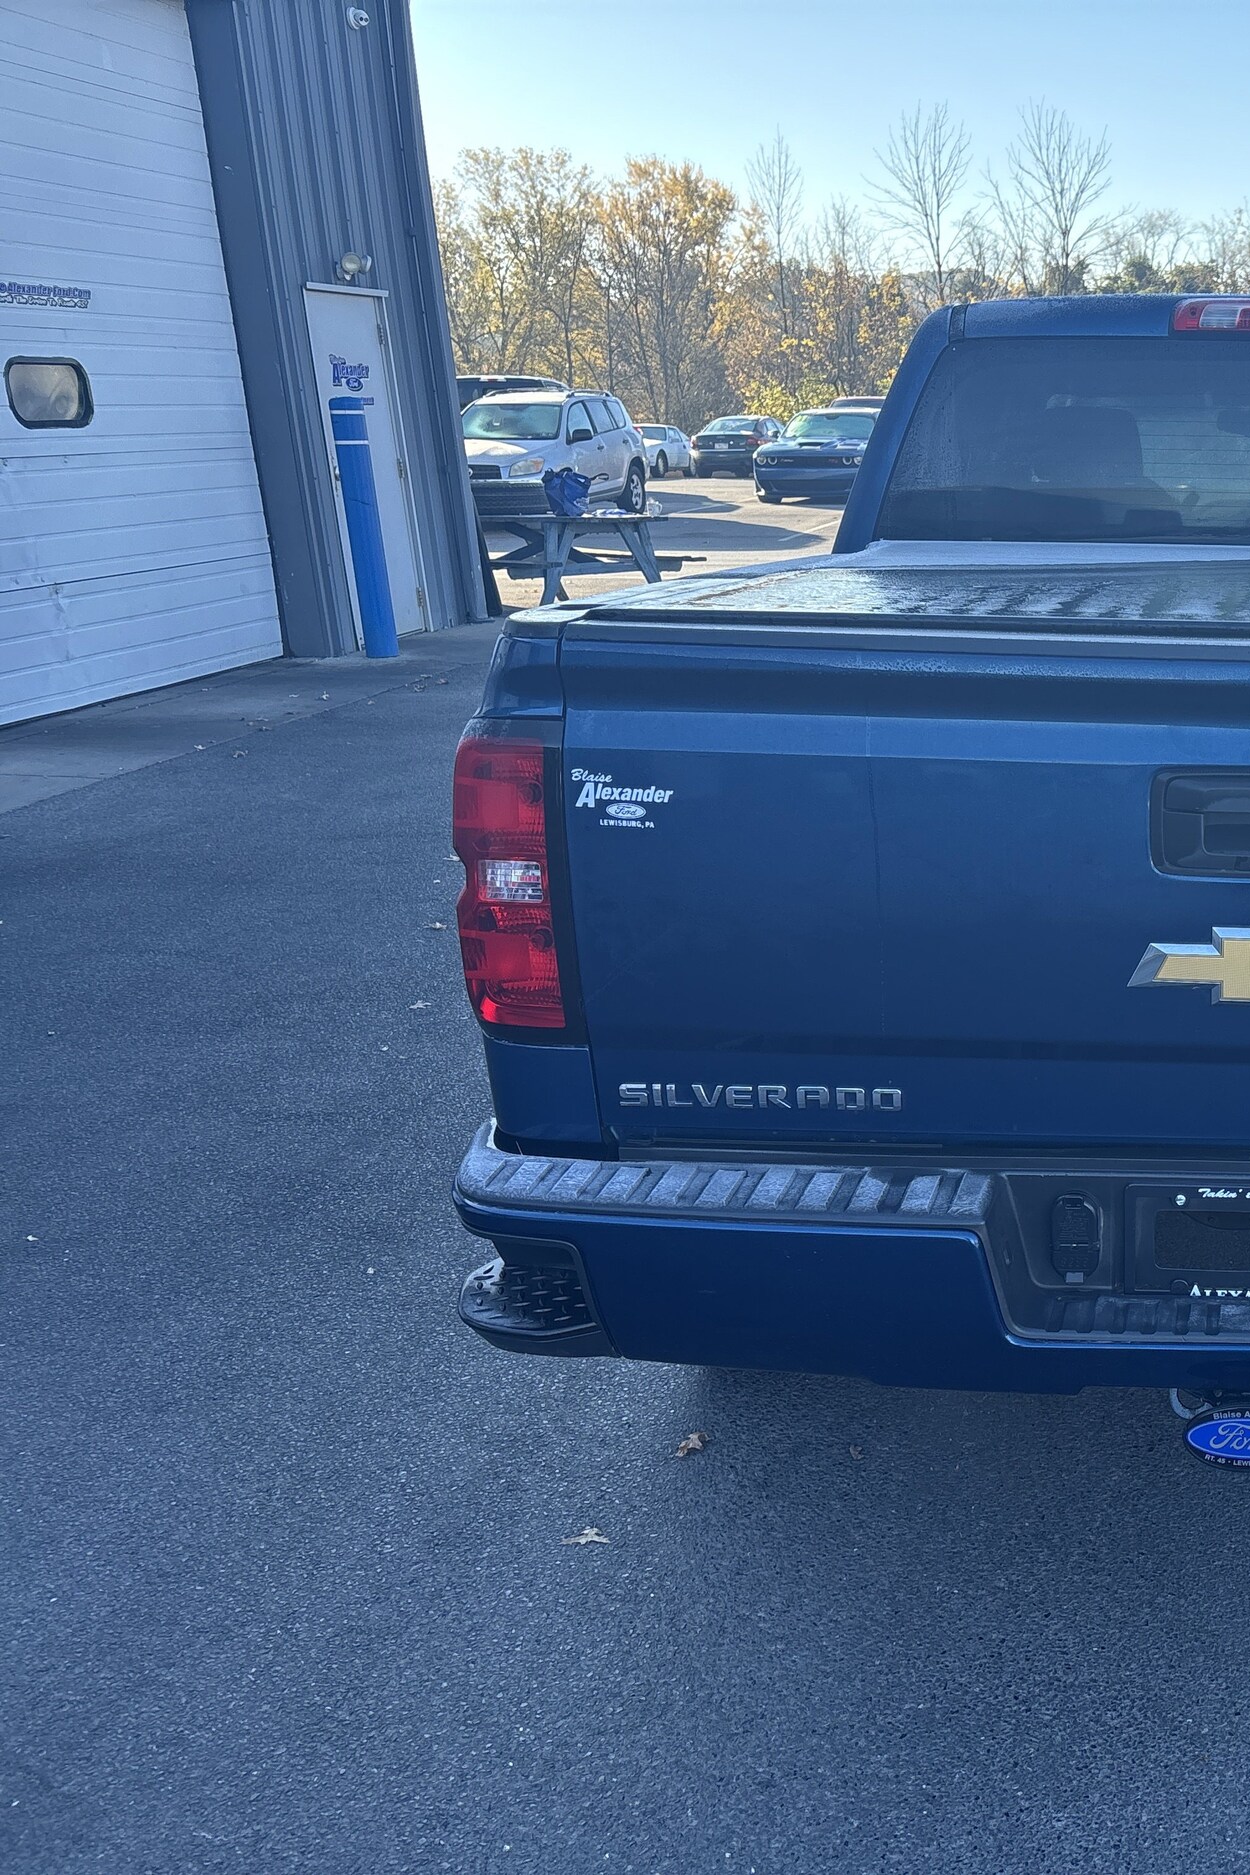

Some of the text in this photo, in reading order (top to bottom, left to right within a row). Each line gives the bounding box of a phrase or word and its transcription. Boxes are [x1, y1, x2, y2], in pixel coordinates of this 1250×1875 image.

[332, 363, 369, 387] Alexander
[571, 768, 612, 782] Blaise
[575, 782, 674, 808] Alexander
[600, 819, 644, 828] LEWISBURG,
[618, 1083, 902, 1112] SILVERADO
[1198, 1188, 1243, 1199] Takin'
[1213, 1411, 1242, 1420] Blaise
[1205, 1454, 1216, 1462] RT.
